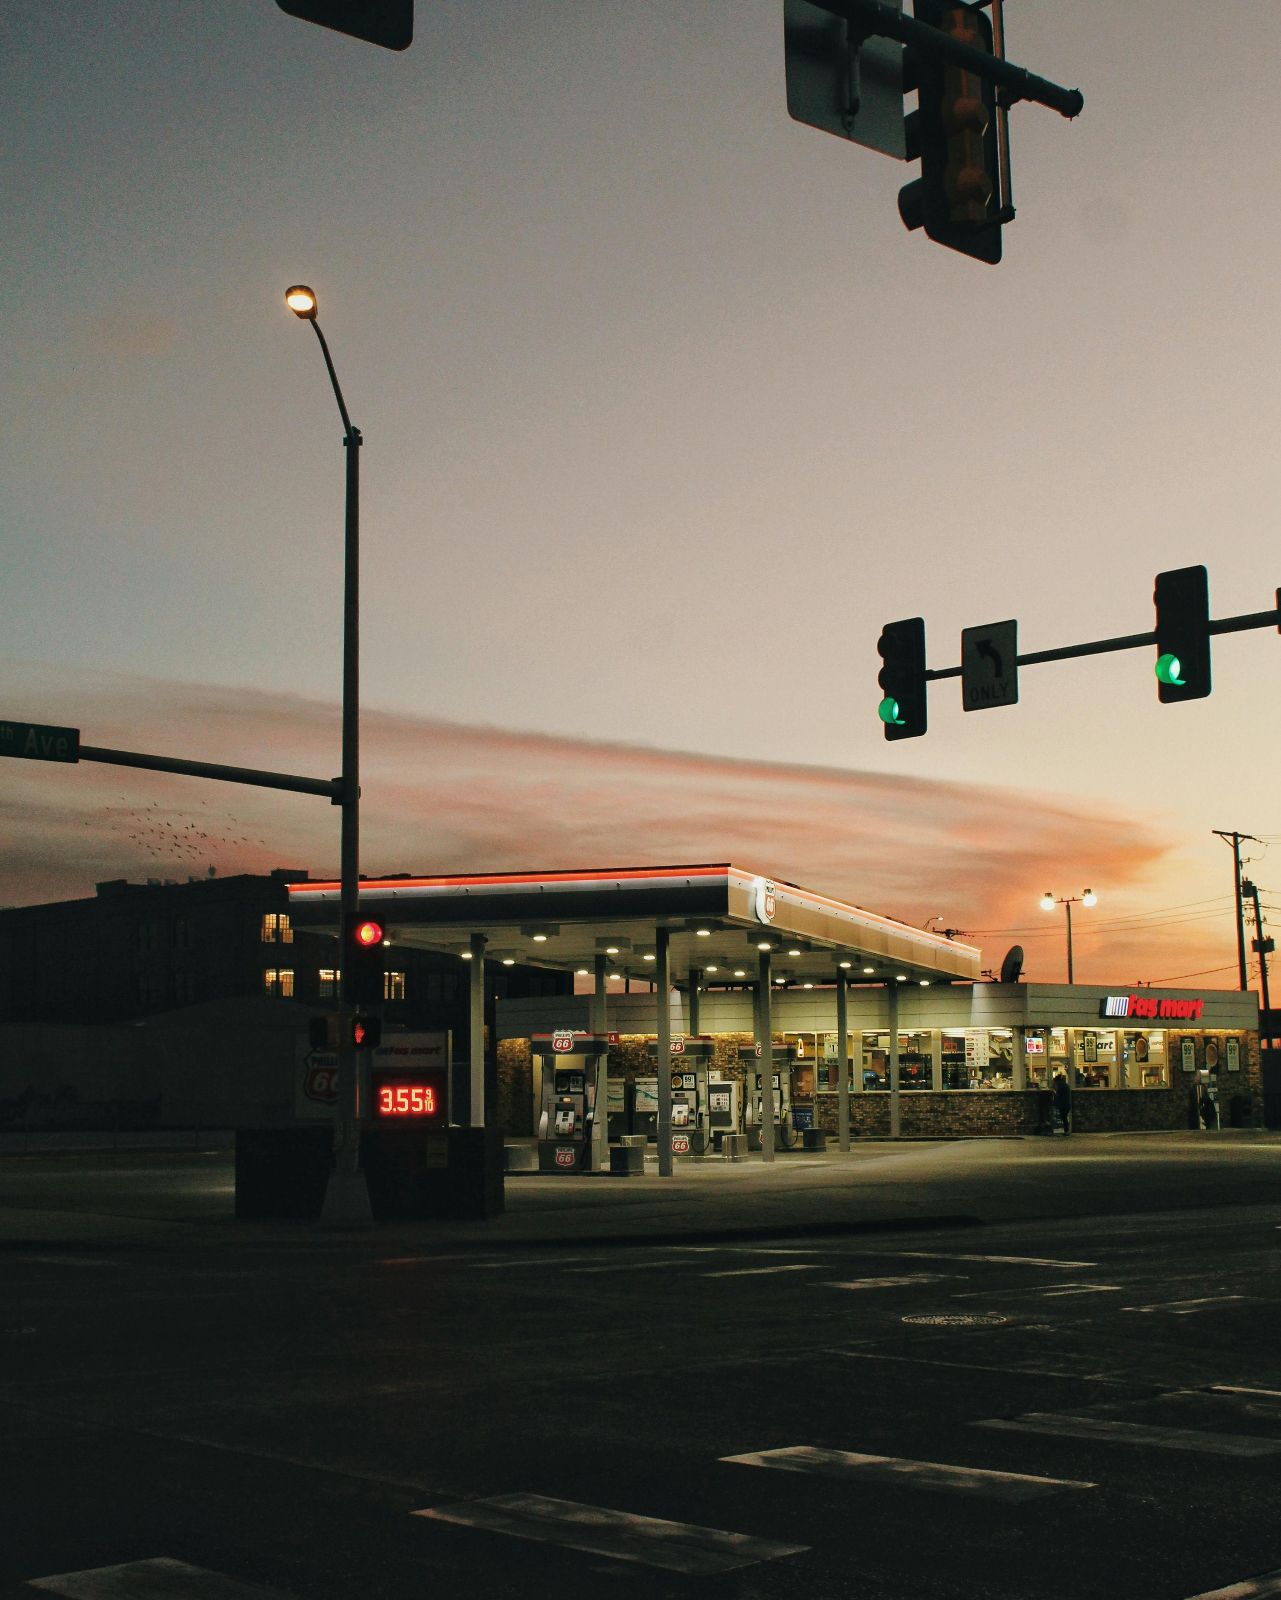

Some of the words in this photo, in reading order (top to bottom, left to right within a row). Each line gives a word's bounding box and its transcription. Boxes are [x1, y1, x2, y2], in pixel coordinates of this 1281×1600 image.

[970, 682, 1010, 702] ONLY
[24, 727, 69, 757] Ave
[1160, 999, 1204, 1019] mart
[556, 1039, 570, 1048] 66
[670, 1042, 682, 1051] 66
[380, 1089, 423, 1112] 3.55
[674, 1142, 687, 1150] 66
[558, 1154, 572, 1163] 66
